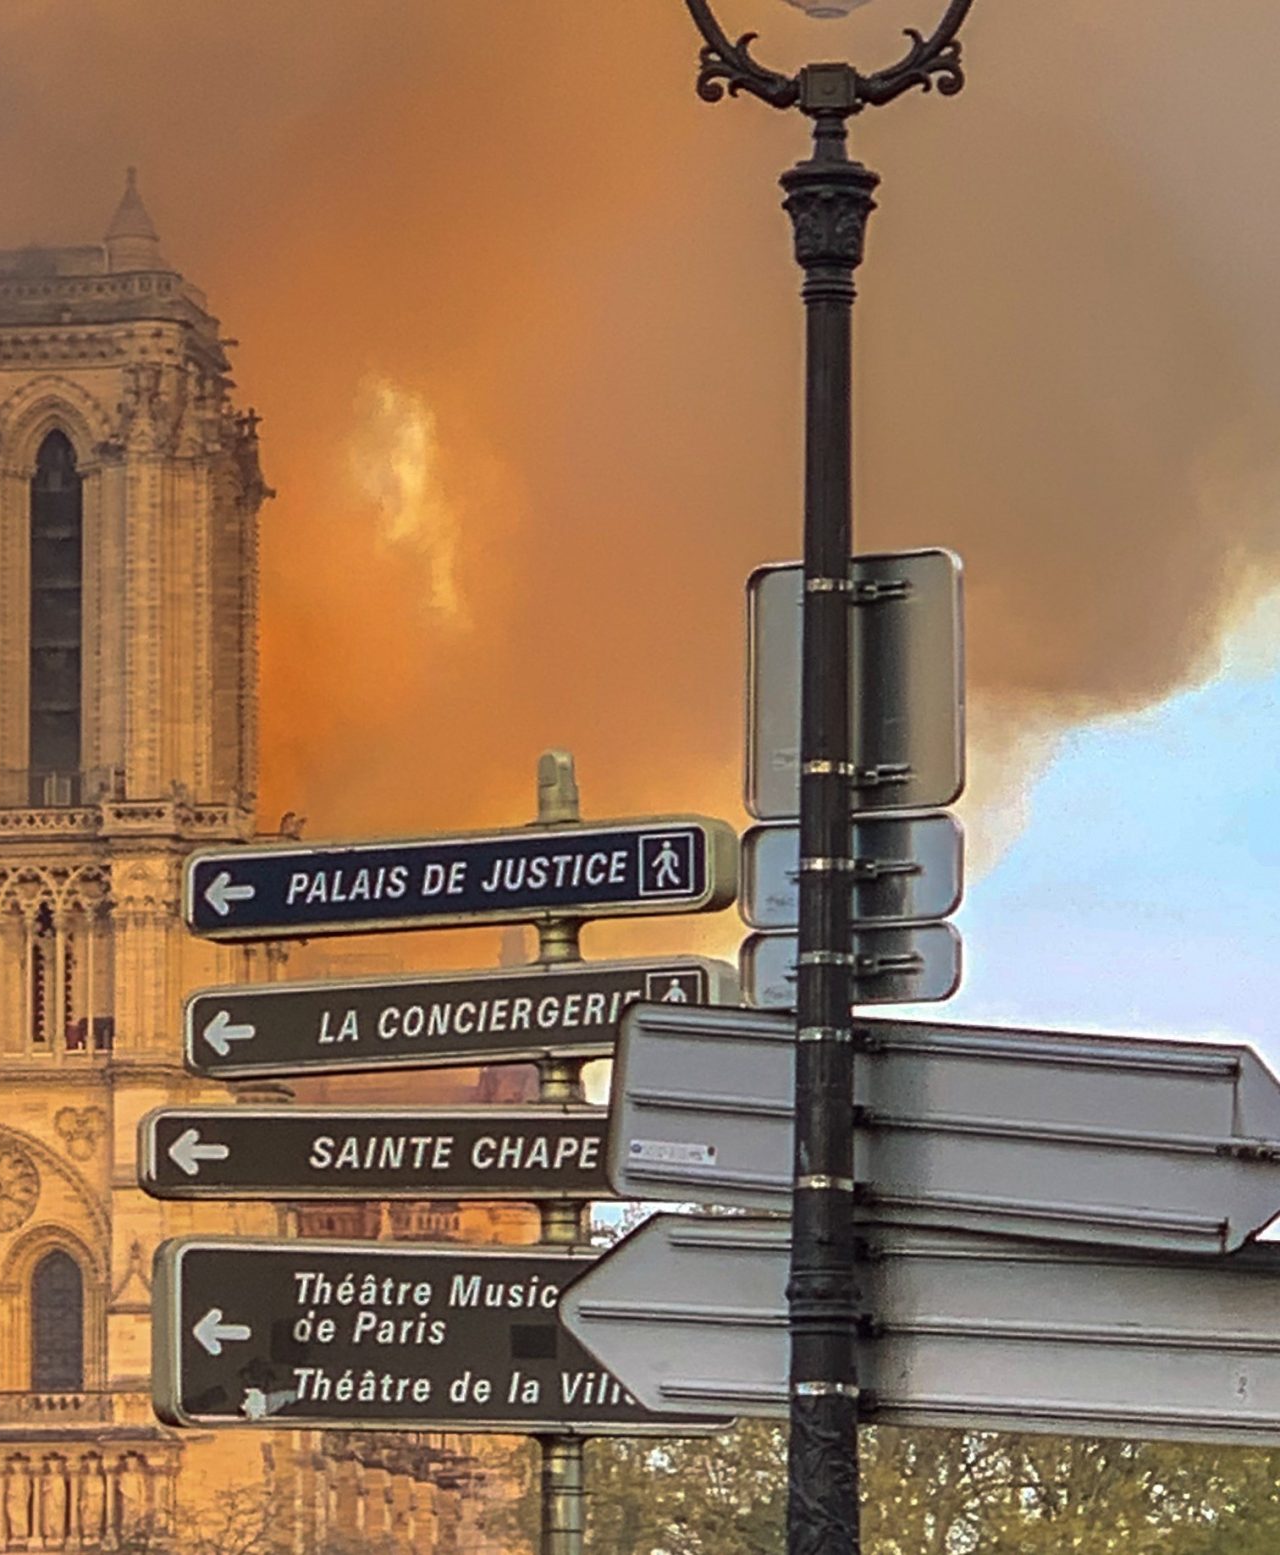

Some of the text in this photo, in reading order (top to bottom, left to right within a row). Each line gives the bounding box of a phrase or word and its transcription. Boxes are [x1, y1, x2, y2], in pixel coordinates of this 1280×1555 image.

[287, 851, 628, 905] PALAIS DE JUSTICE
[319, 1010, 359, 1044] LA
[309, 1136, 454, 1170] SAINTE
[471, 1137, 601, 1169] CHAPE
[294, 1271, 559, 1308] Théâtre Music
[293, 1310, 447, 1345] de Paris
[293, 1367, 636, 1405] Théâtre de la Vill
